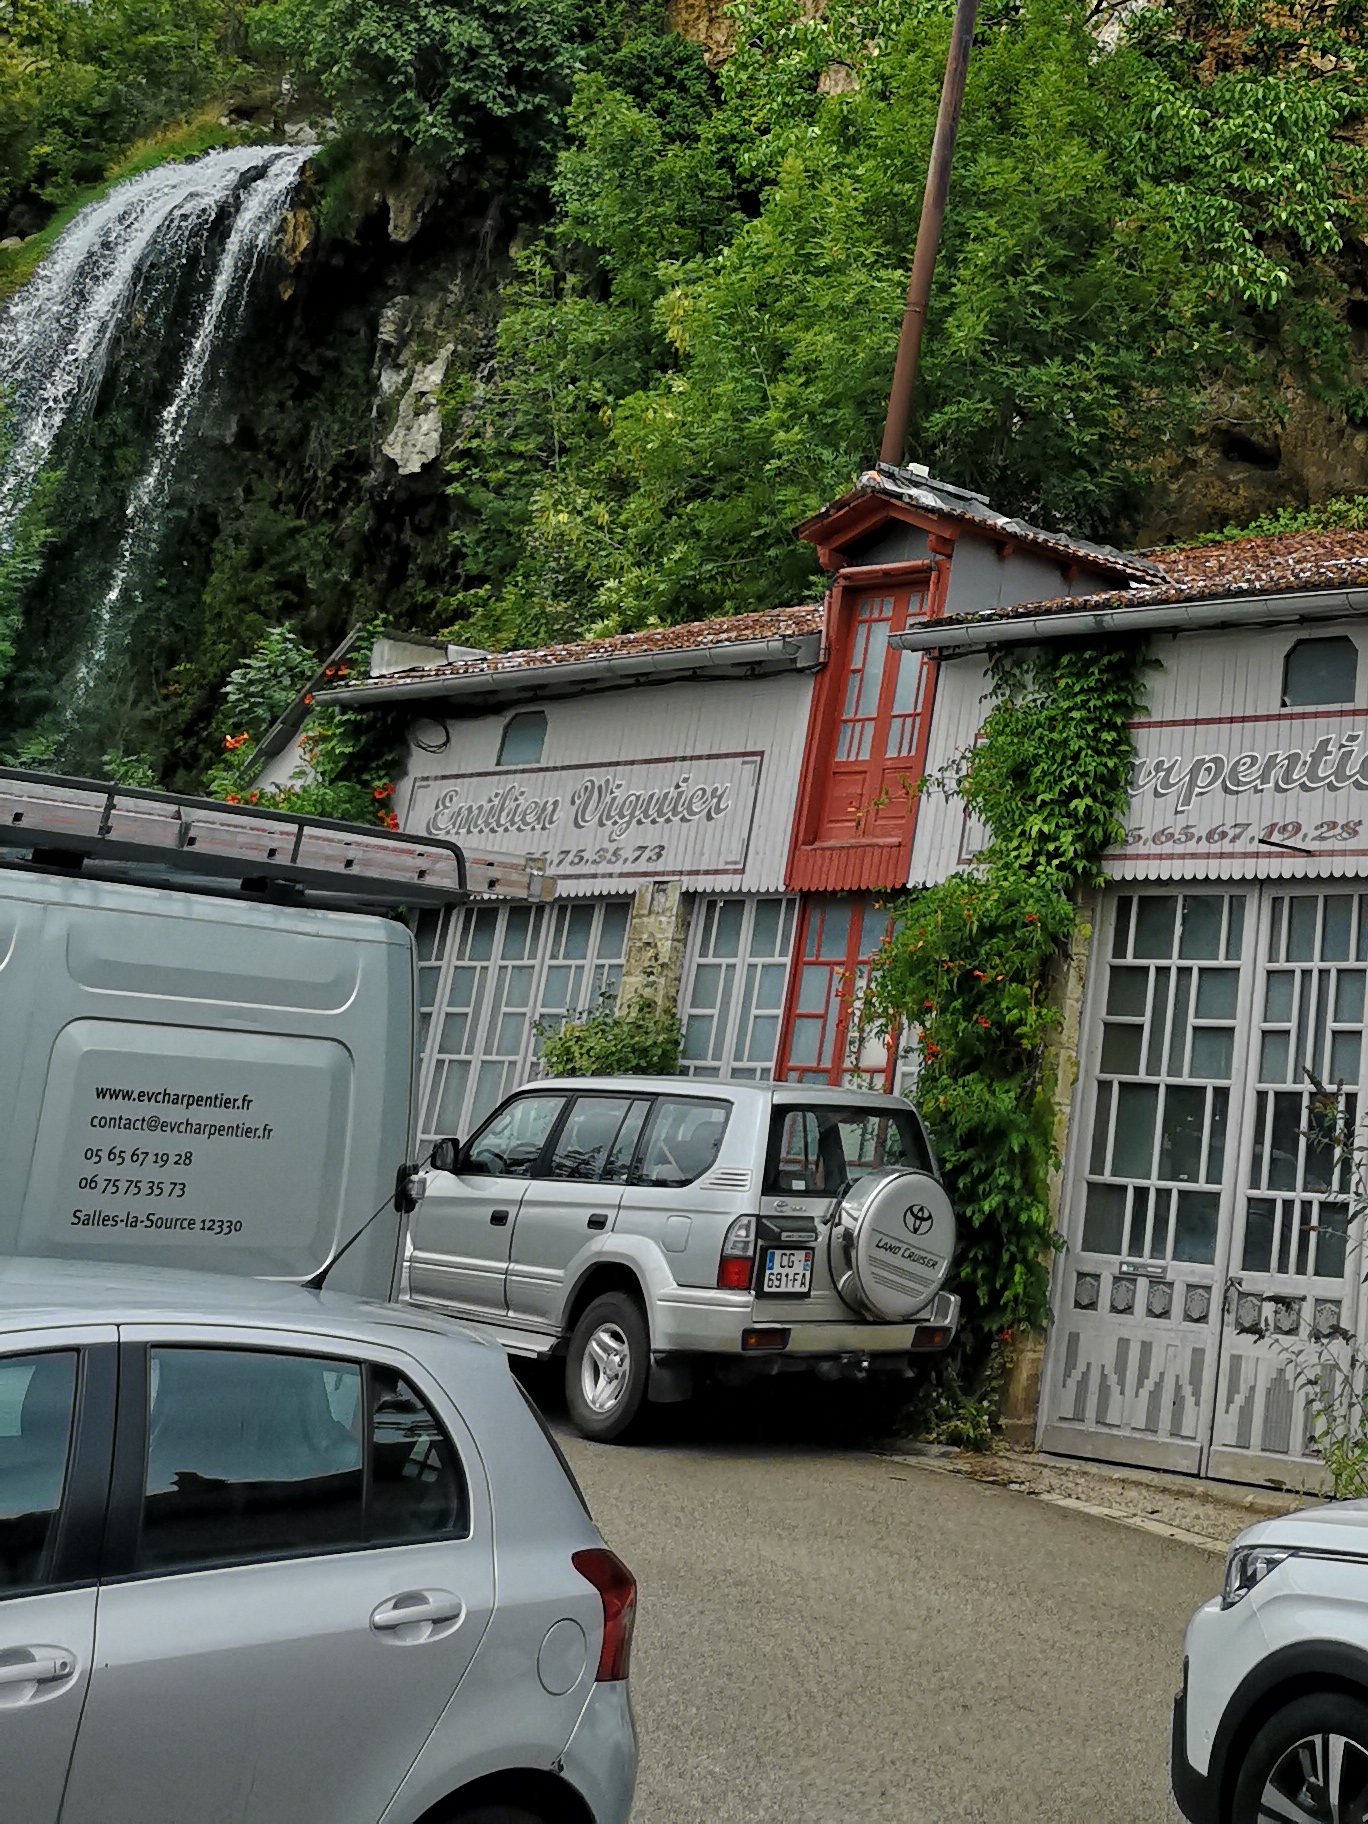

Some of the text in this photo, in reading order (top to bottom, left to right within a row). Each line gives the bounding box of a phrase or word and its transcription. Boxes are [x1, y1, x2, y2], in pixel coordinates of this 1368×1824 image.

[426, 774, 731, 842] Emilien Viguier
[95, 1086, 253, 1111] www.evcharpentier.fr
[90, 1115, 273, 1140] contact@evcharpentier.fr
[84, 1146, 193, 1168] 05 65 67 19 28
[78, 1174, 186, 1198] 06 75 75 35 73
[70, 1209, 242, 1235] Salles-la-Source 12330
[875, 1237, 939, 1270] LAND CRUISER
